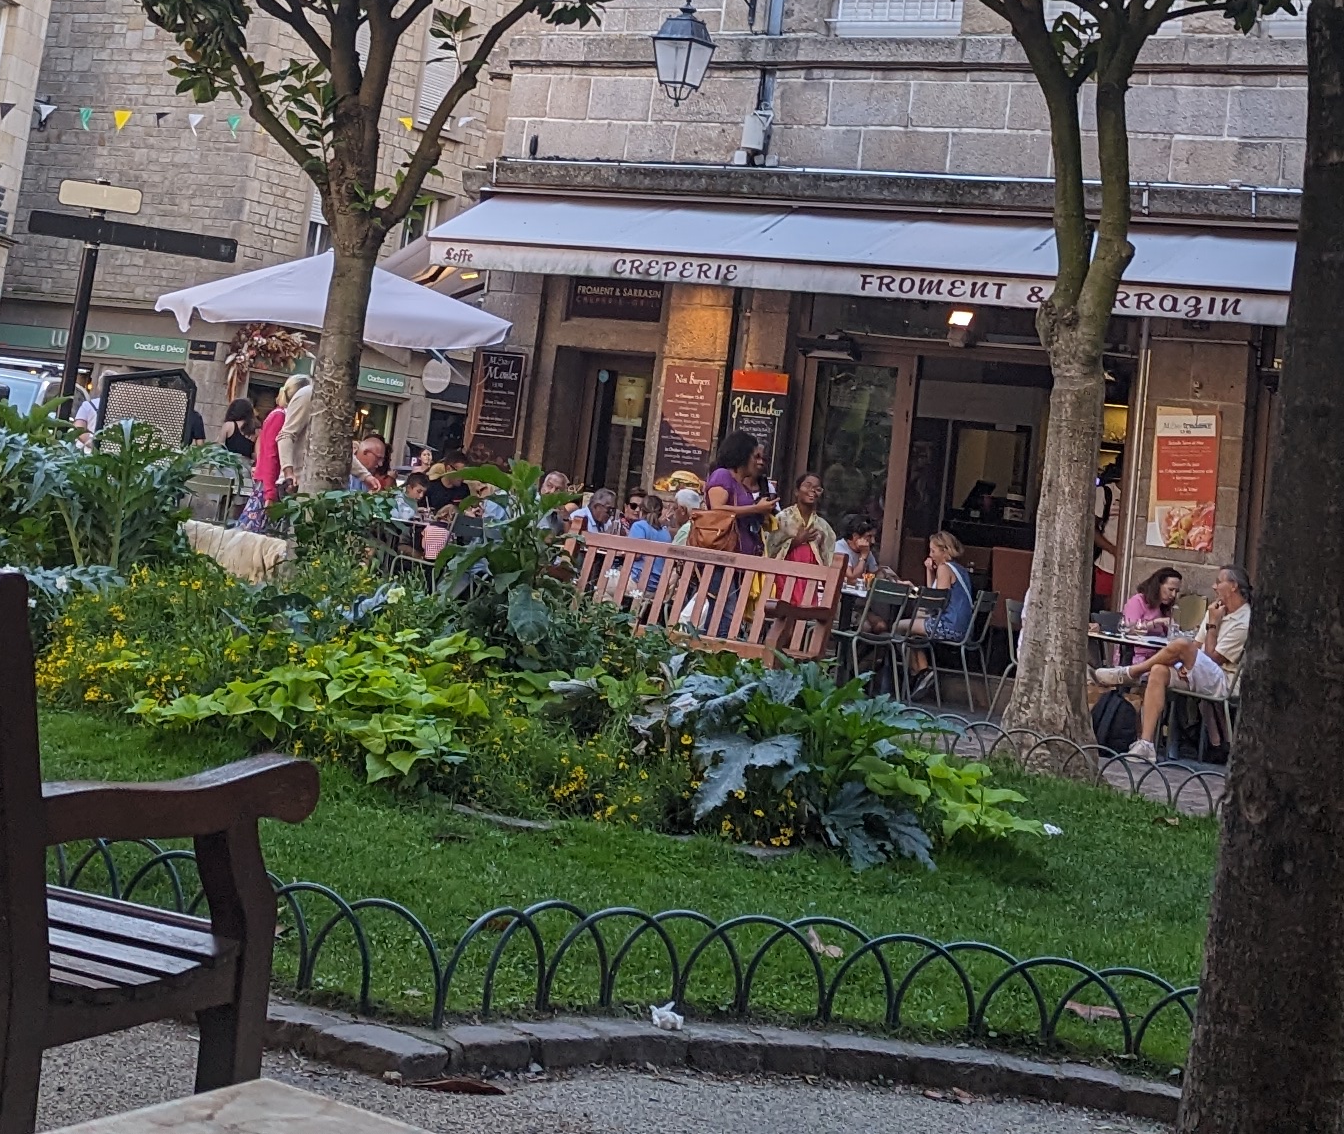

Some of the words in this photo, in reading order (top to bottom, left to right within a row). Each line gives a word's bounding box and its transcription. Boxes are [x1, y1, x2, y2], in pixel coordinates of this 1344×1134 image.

[443, 247, 474, 263] Leffe
[613, 258, 739, 281] CREPERIE
[577, 285, 615, 296] FROMENT
[622, 287, 662, 299] SARRASIN
[860, 274, 1008, 300] FROMENT
[1027, 286, 1045, 303] &
[1114, 291, 1242, 318] RRAZIN
[51, 330, 111, 352] WOD
[134, 342, 160, 352] Cactus
[166, 344, 185, 354] Déco
